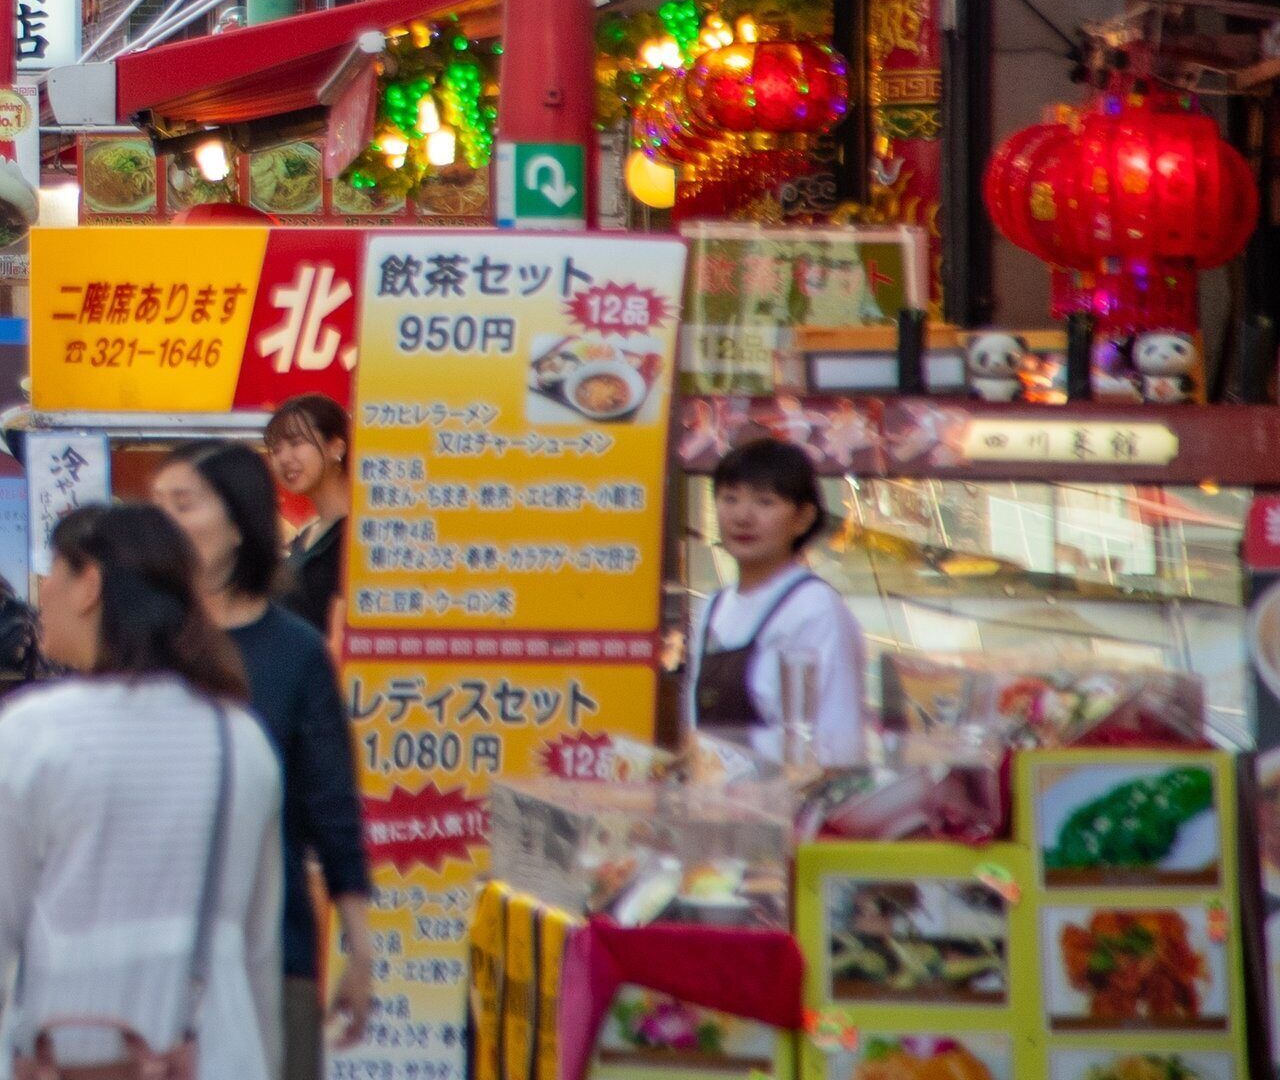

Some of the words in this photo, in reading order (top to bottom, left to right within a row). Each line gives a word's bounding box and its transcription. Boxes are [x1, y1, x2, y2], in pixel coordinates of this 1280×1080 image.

[375, 253, 595, 299] 飲茶セット
[49, 283, 248, 325] 二階席あります
[258, 265, 358, 376] 北
[586, 293, 650, 326] 12品
[90, 338, 223, 369] 321-1646
[397, 314, 516, 354] 950円
[350, 679, 597, 724] レディスセット
[363, 732, 501, 773] 1,080円
